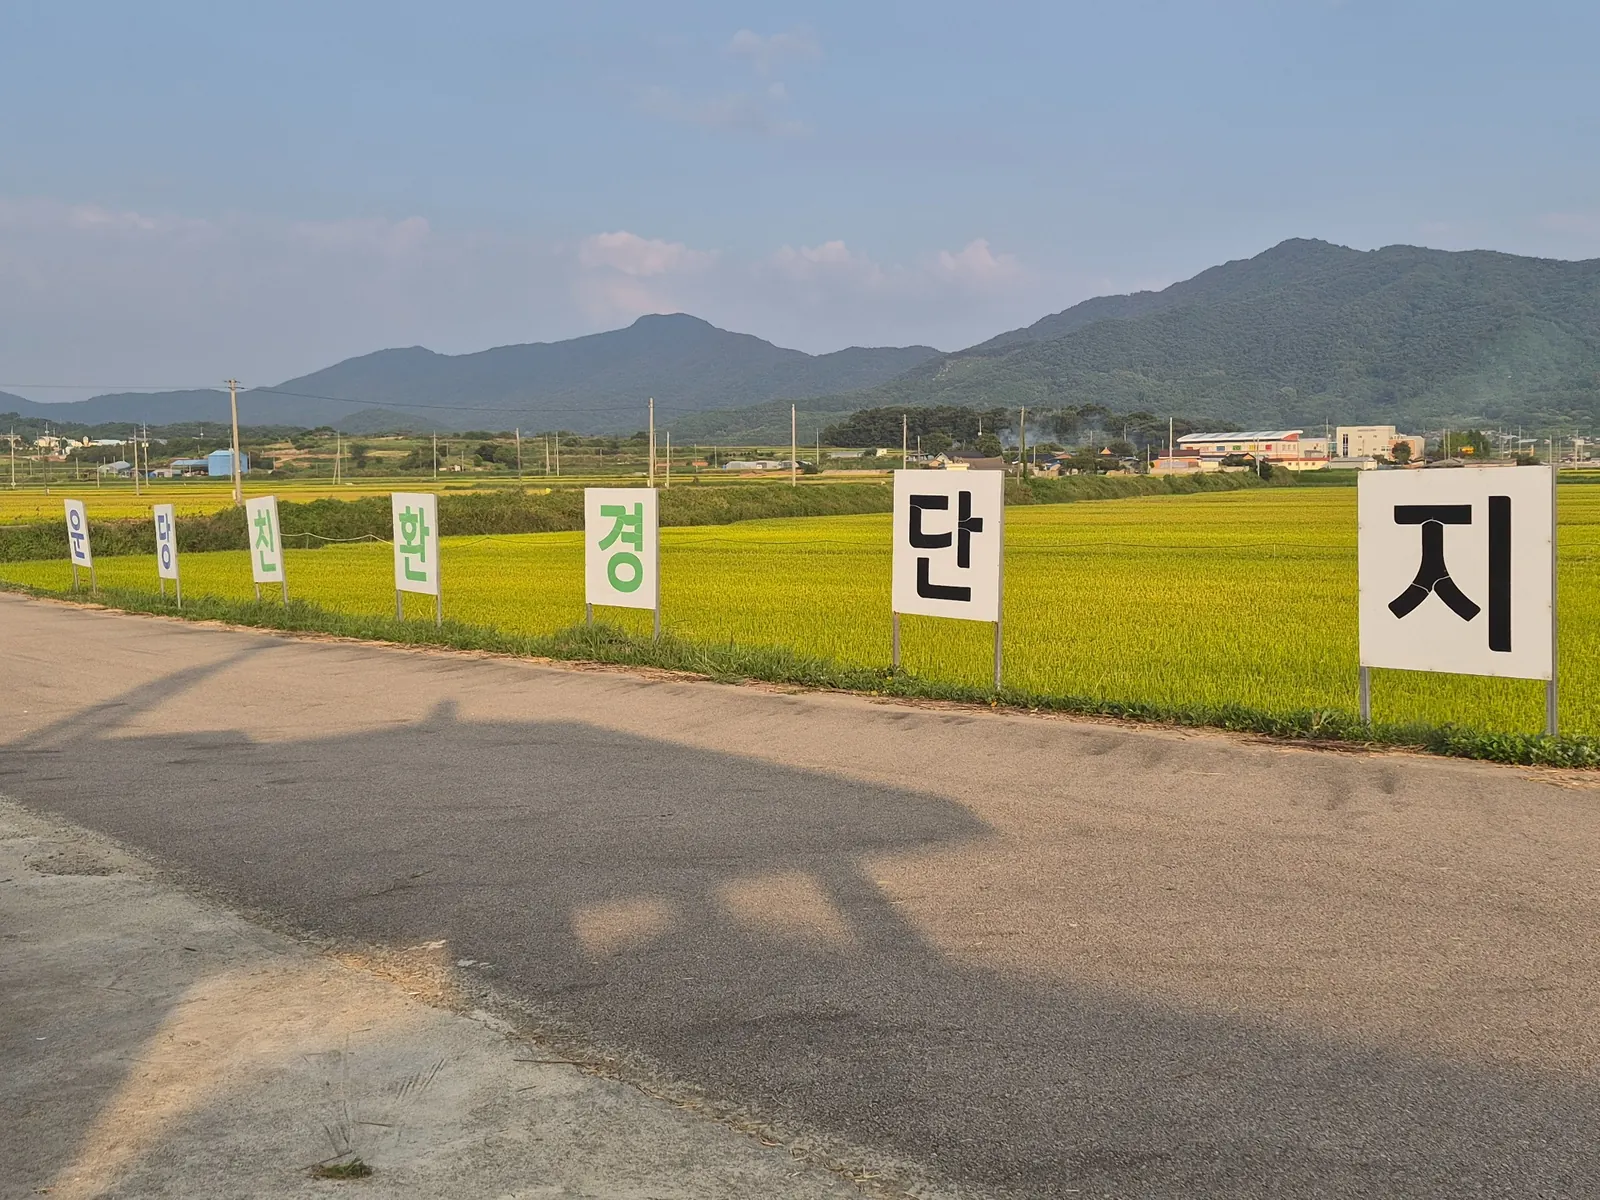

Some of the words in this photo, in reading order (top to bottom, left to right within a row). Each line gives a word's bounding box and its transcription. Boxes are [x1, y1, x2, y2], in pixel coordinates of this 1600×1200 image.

[69, 508, 85, 559] 운
[157, 512, 171, 570] 당
[253, 508, 277, 573] 친
[399, 506, 430, 582] 환
[599, 502, 644, 594] 경
[908, 490, 983, 602] 단
[1388, 496, 1513, 652] 지
